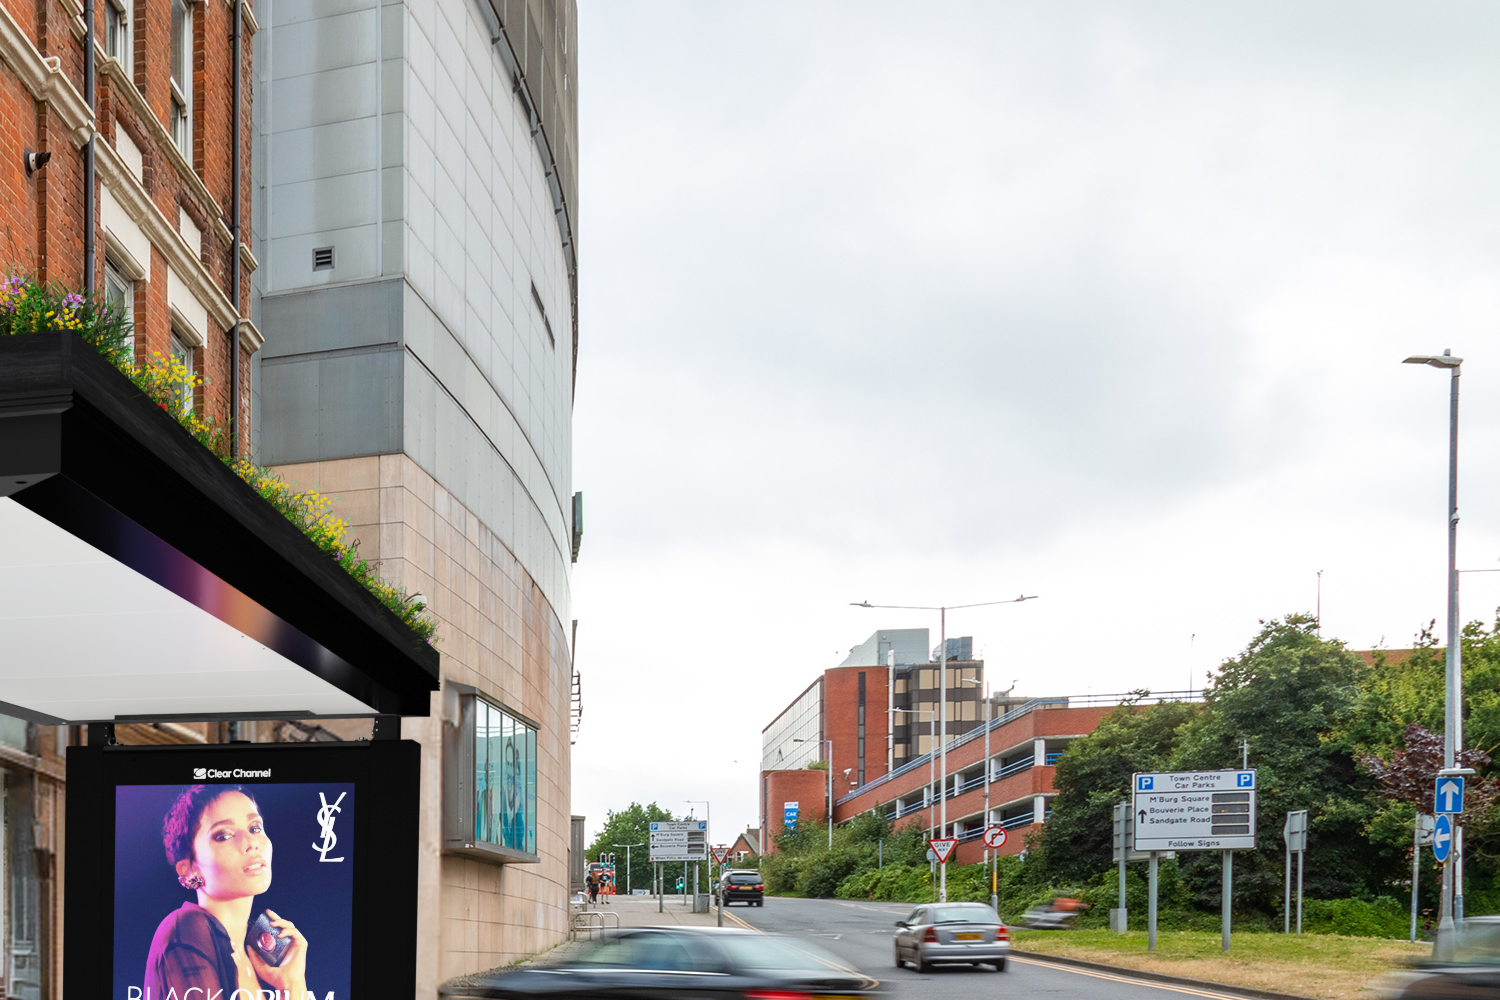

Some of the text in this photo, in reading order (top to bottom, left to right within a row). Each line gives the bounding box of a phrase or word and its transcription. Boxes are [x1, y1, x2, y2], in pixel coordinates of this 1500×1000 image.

[208, 768, 272, 778] Clear Channel
[1182, 795, 1210, 803] Square
[1150, 806, 1186, 814] Bouverie
[1168, 840, 1220, 848] Follow Signs
